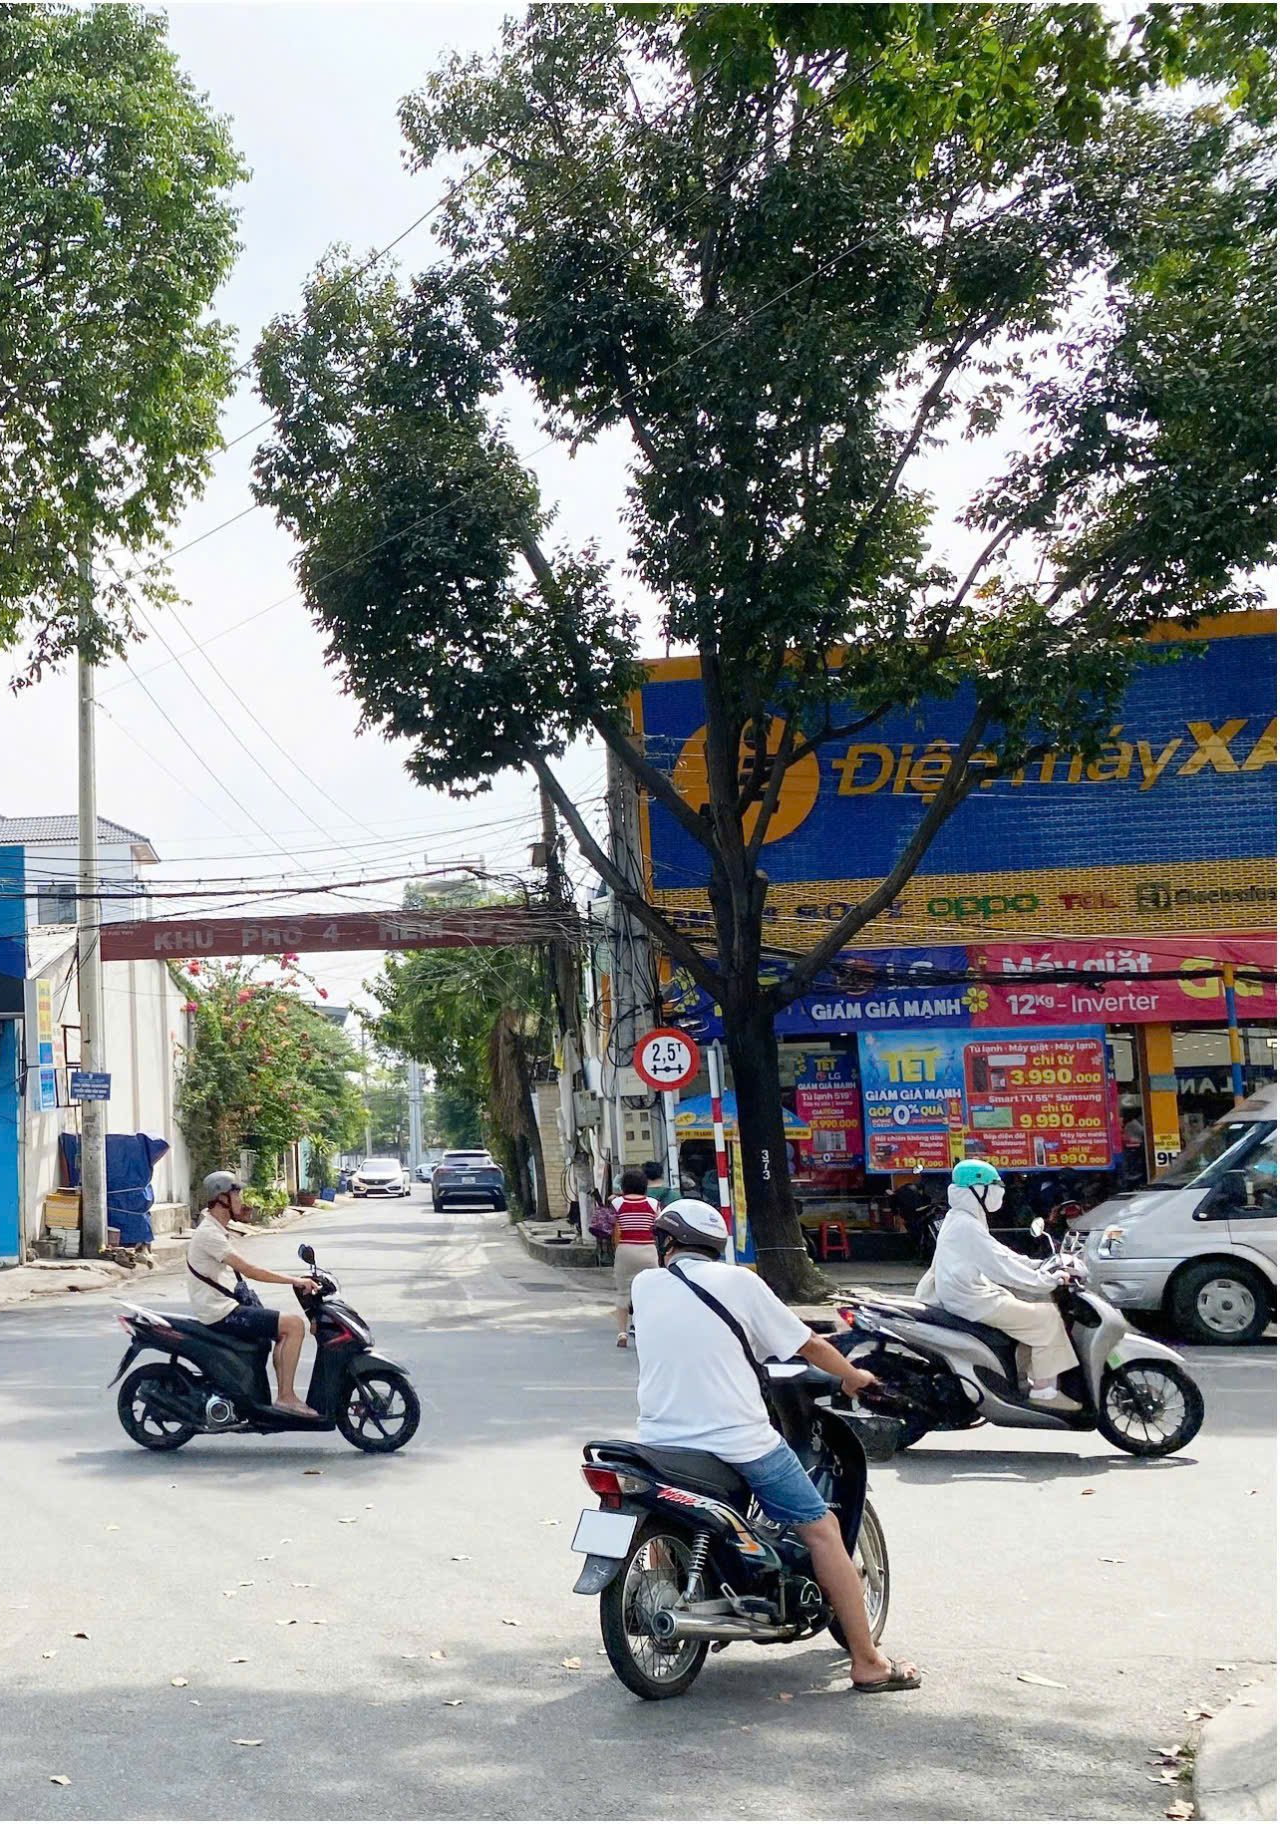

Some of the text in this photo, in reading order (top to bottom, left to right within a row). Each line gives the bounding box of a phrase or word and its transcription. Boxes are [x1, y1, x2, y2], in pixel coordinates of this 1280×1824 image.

[796, 900, 906, 922] SOY
[154, 929, 214, 951] KHU
[322, 924, 338, 943] 4
[903, 998, 961, 1019] MẠNH
[1071, 992, 1159, 1013] Inverter
[828, 1072, 841, 1080] LG
[1010, 1068, 1101, 1085] 3.990.000
[988, 1094, 1018, 1103] Smart
[1020, 1094, 1033, 1102] TV
[1056, 1093, 1102, 1103] Samsung
[1020, 1113, 1101, 1128] 9.990.000
[761, 1149, 771, 1180] 373
